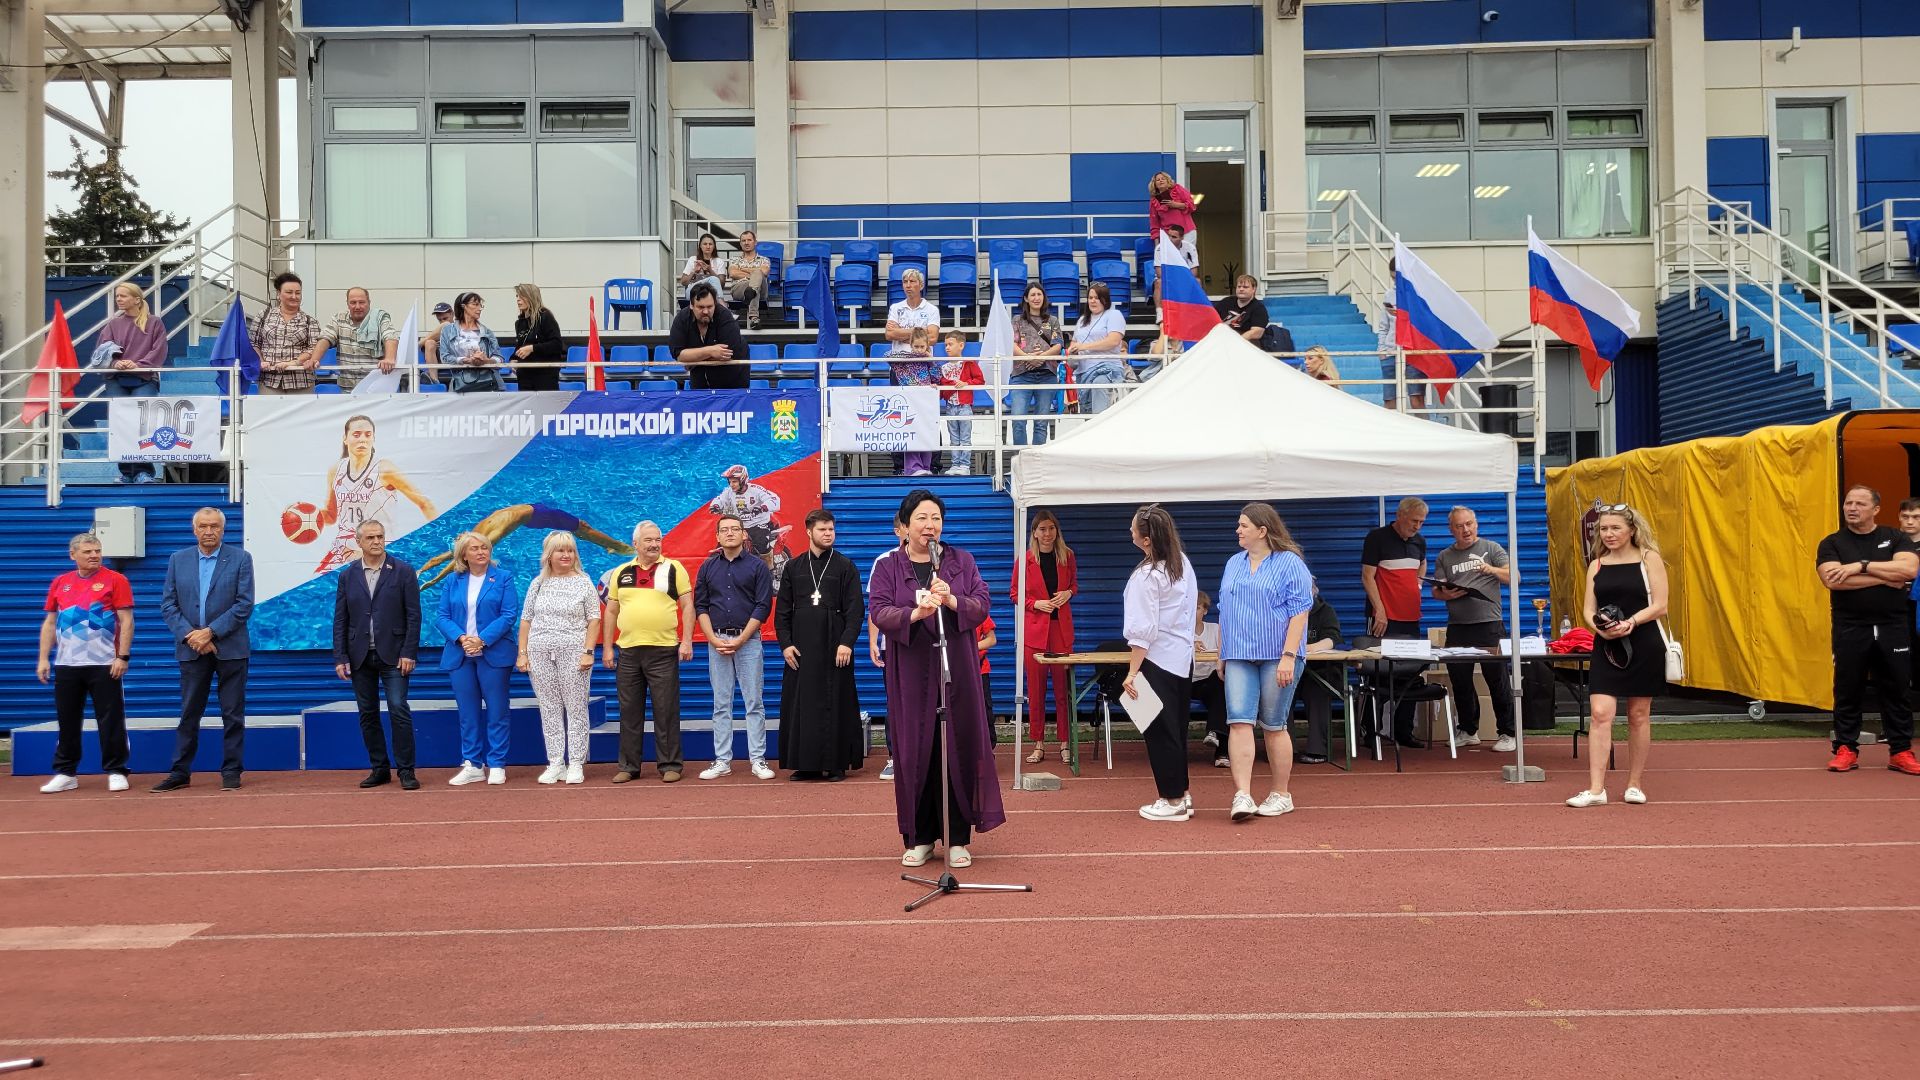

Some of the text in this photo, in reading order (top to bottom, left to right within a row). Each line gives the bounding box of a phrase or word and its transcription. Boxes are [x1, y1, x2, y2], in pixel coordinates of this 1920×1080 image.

[182, 412, 199, 420] ЛЕТ
[399, 407, 754, 438] ЛЕНИНСКИЙ ГОРОДСКОЙ ОКРУГ
[855, 432, 916, 441] МИНСПОРТ
[863, 442, 908, 452] РОССИИ
